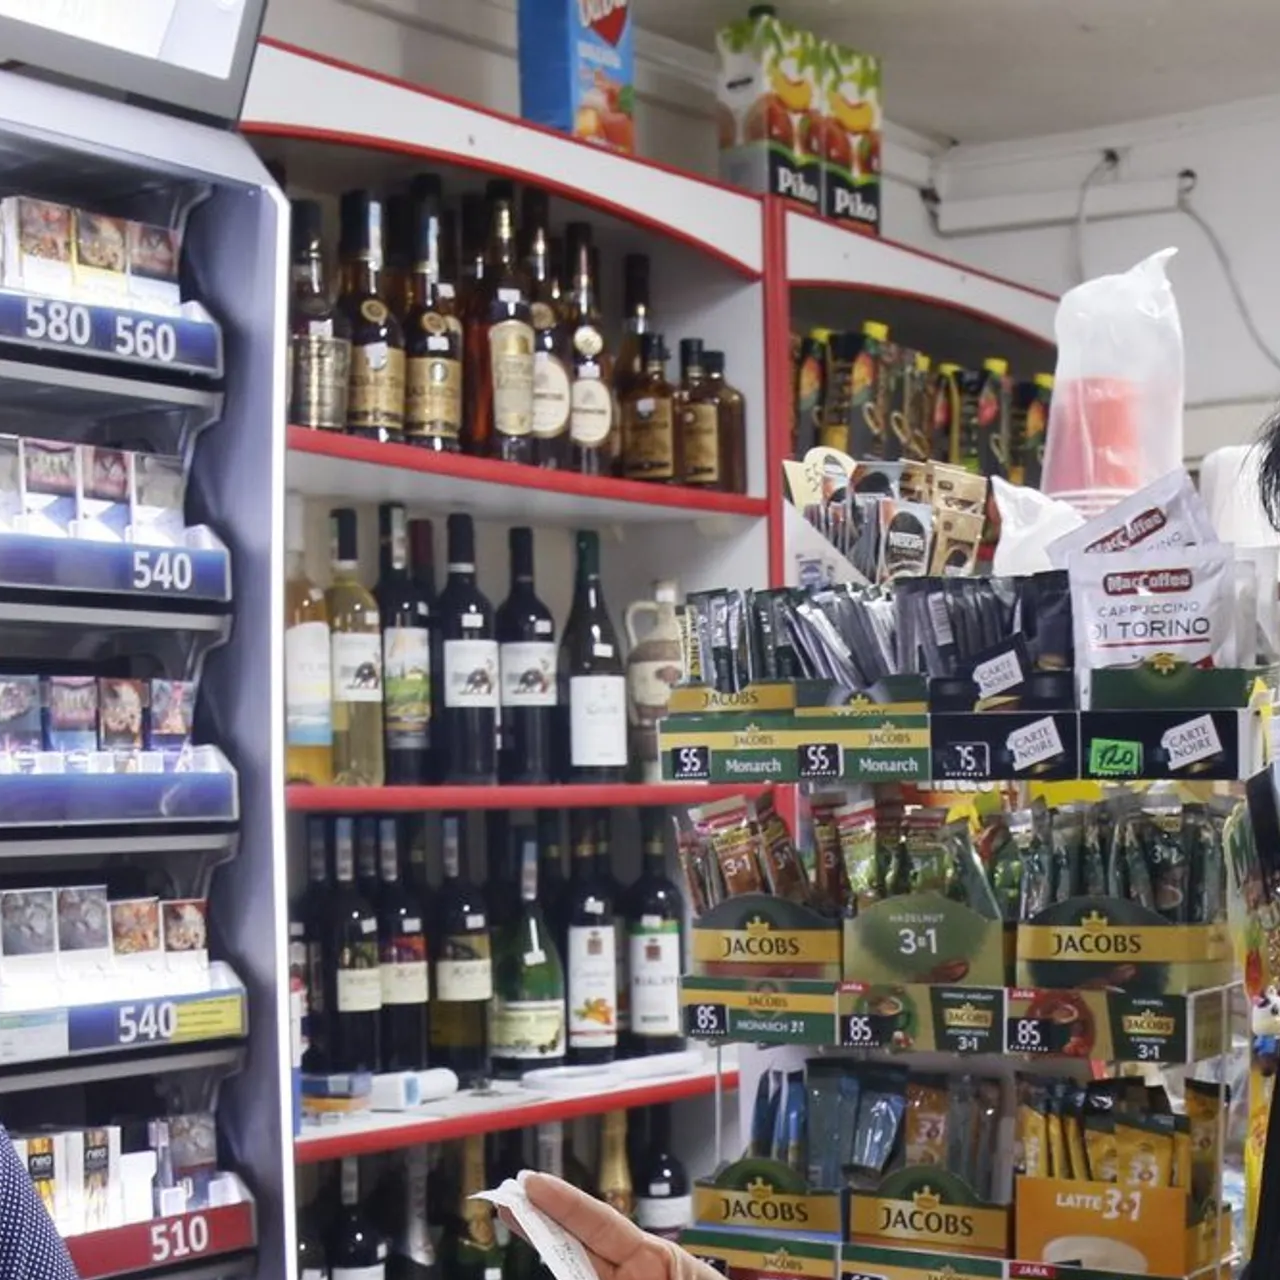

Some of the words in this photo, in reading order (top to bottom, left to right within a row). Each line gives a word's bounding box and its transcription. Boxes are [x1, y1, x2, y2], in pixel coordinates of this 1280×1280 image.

[778, 167, 818, 203] Piko
[834, 187, 878, 222] Piko
[25, 300, 90, 345] 580
[115, 316, 176, 363] 560
[133, 552, 192, 590] 540
[1098, 601, 1200, 618] CAPPUCCINO
[1117, 617, 1210, 639] TORINO
[703, 690, 758, 706] JACOBS
[868, 733, 911, 745] JACOBS
[1013, 725, 1052, 748] CARTE
[1169, 723, 1208, 747] CARTE
[1018, 738, 1054, 760] NOIRE
[1173, 736, 1213, 760] NOIRE
[725, 758, 781, 773] Monarch
[859, 757, 918, 773] Monarch
[722, 936, 800, 956] JACOBS
[1053, 934, 1142, 955] JACOBS
[747, 994, 788, 1008] JACOBS
[120, 1001, 179, 1043] 540
[737, 1021, 788, 1033] MONARCH
[721, 1199, 809, 1223] JACOBS
[1056, 1192, 1103, 1211] LATTE
[880, 1207, 974, 1237] JACOBS
[151, 1216, 209, 1261] 510
